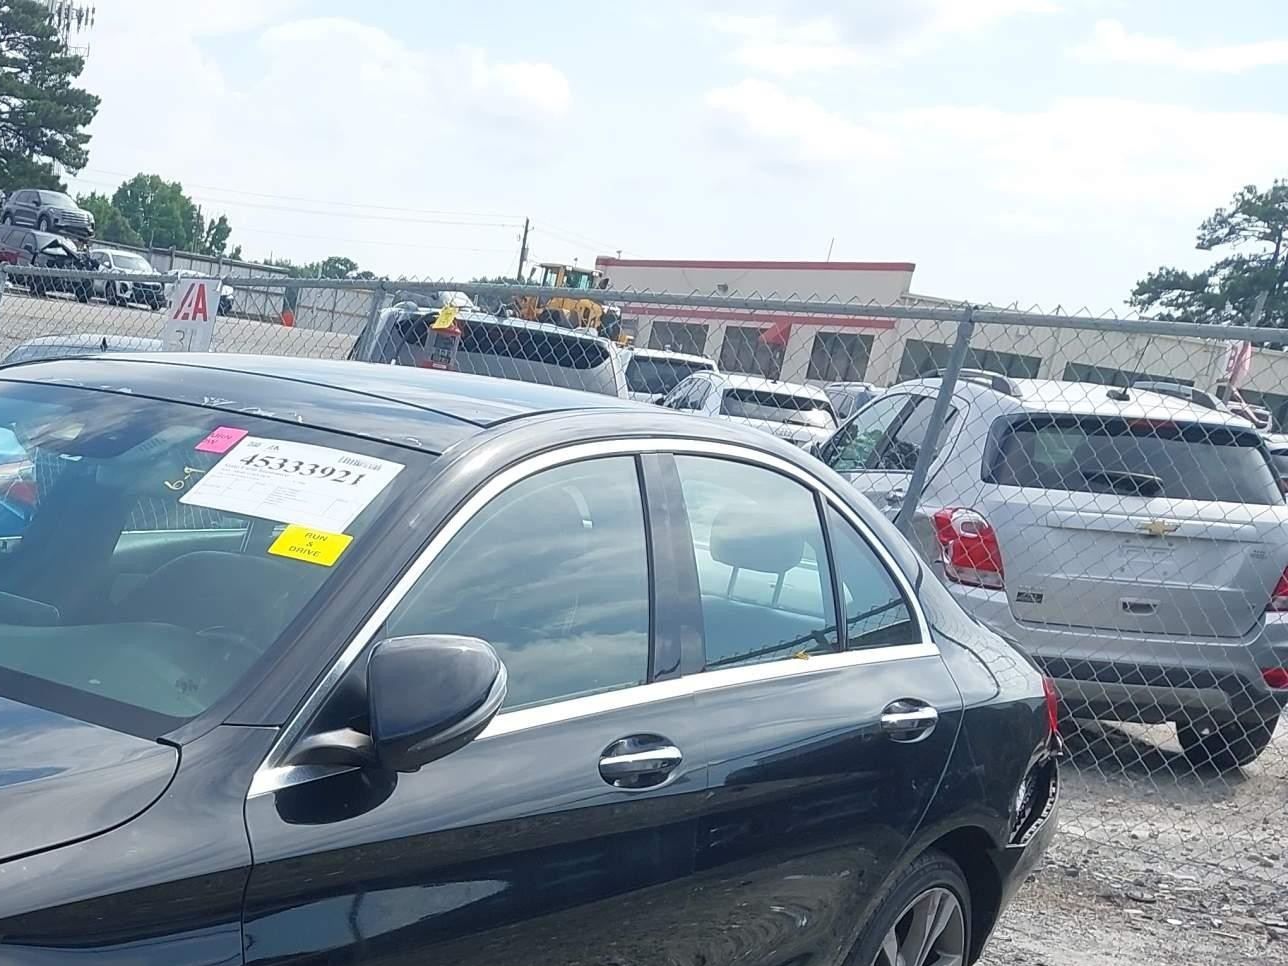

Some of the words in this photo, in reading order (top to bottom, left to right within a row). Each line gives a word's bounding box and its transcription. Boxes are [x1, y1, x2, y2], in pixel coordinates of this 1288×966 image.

[240, 453, 366, 486] 45333921
[304, 532, 329, 542] RUN
[288, 545, 321, 558] DRIVE
